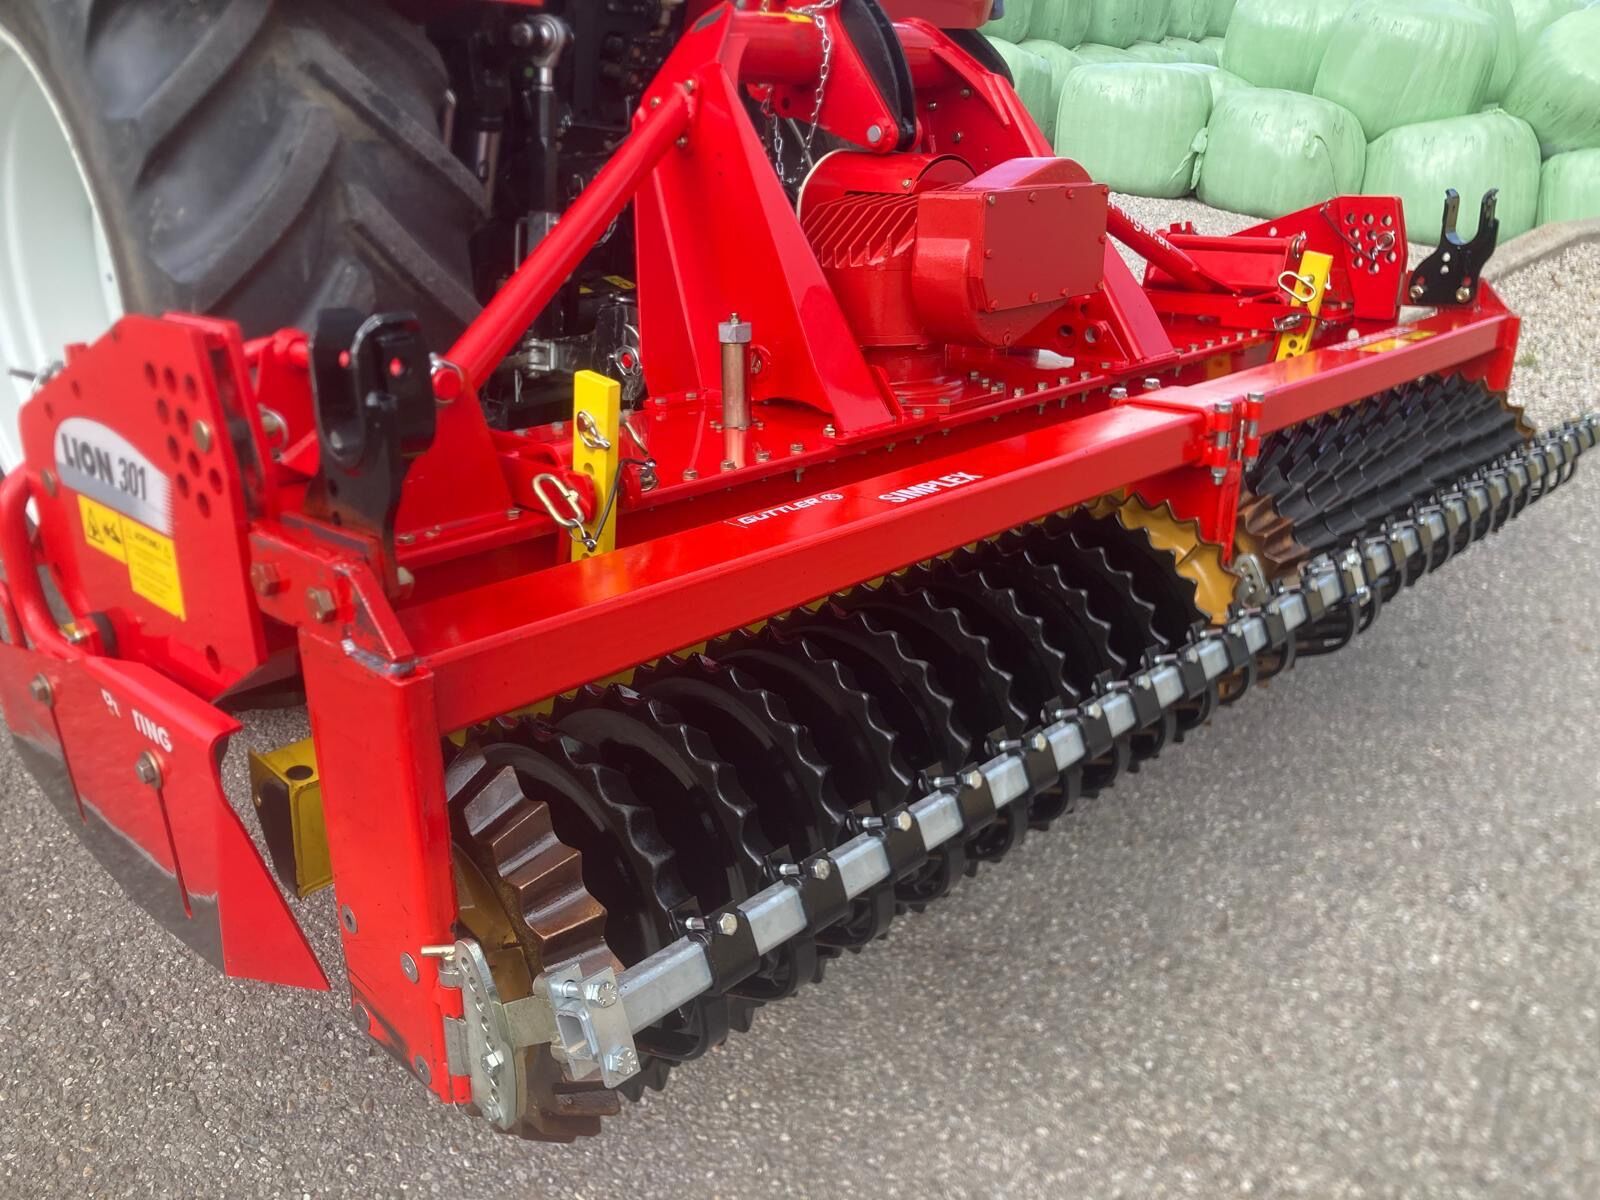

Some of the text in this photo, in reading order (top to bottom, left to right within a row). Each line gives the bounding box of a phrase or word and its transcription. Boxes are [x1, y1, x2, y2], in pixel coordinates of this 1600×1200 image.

[61, 432, 147, 501] LION 301
[878, 471, 983, 503] SIMPLEX
